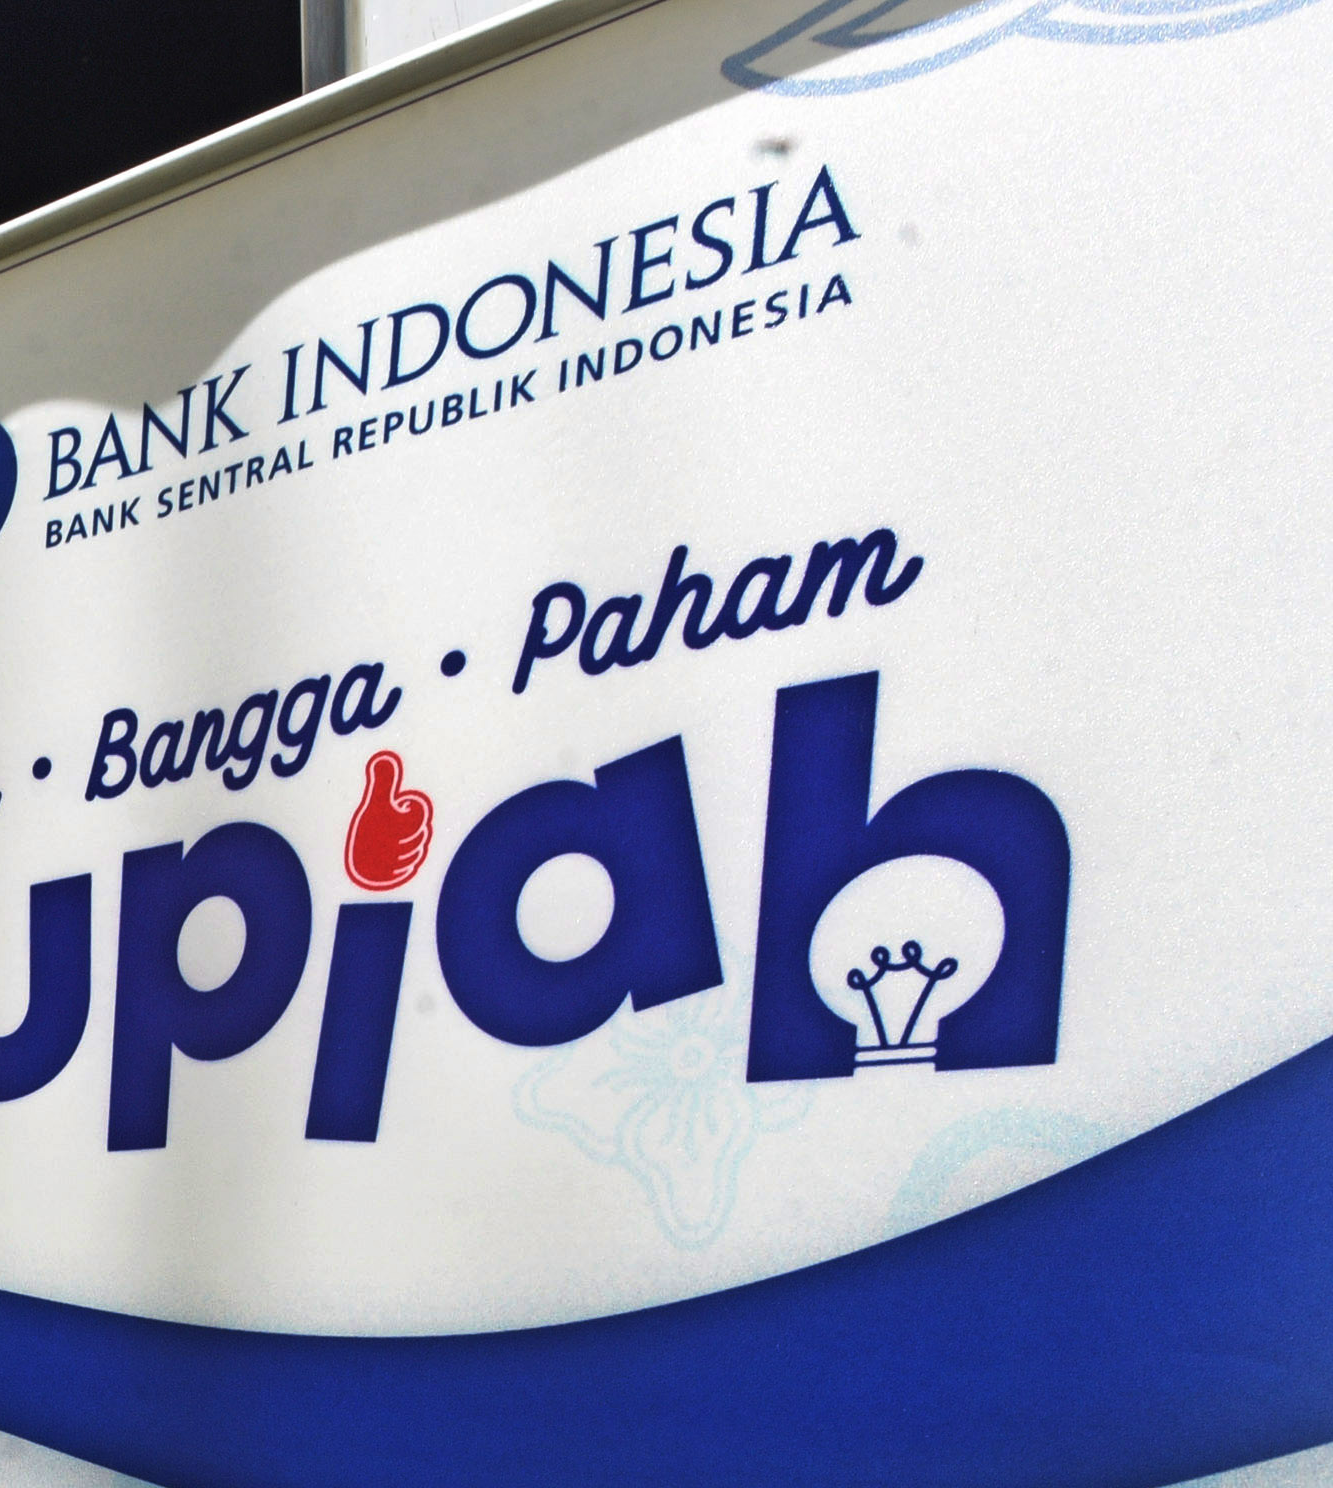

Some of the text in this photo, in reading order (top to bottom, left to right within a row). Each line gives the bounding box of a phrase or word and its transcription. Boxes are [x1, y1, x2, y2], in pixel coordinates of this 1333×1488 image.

[44, 165, 861, 505] BANK INDONESIA
[46, 274, 852, 548] BANK SENTRAL REPUBLIK INDONESIA
[87, 660, 402, 802] Bangga
[513, 527, 923, 693] Paham
